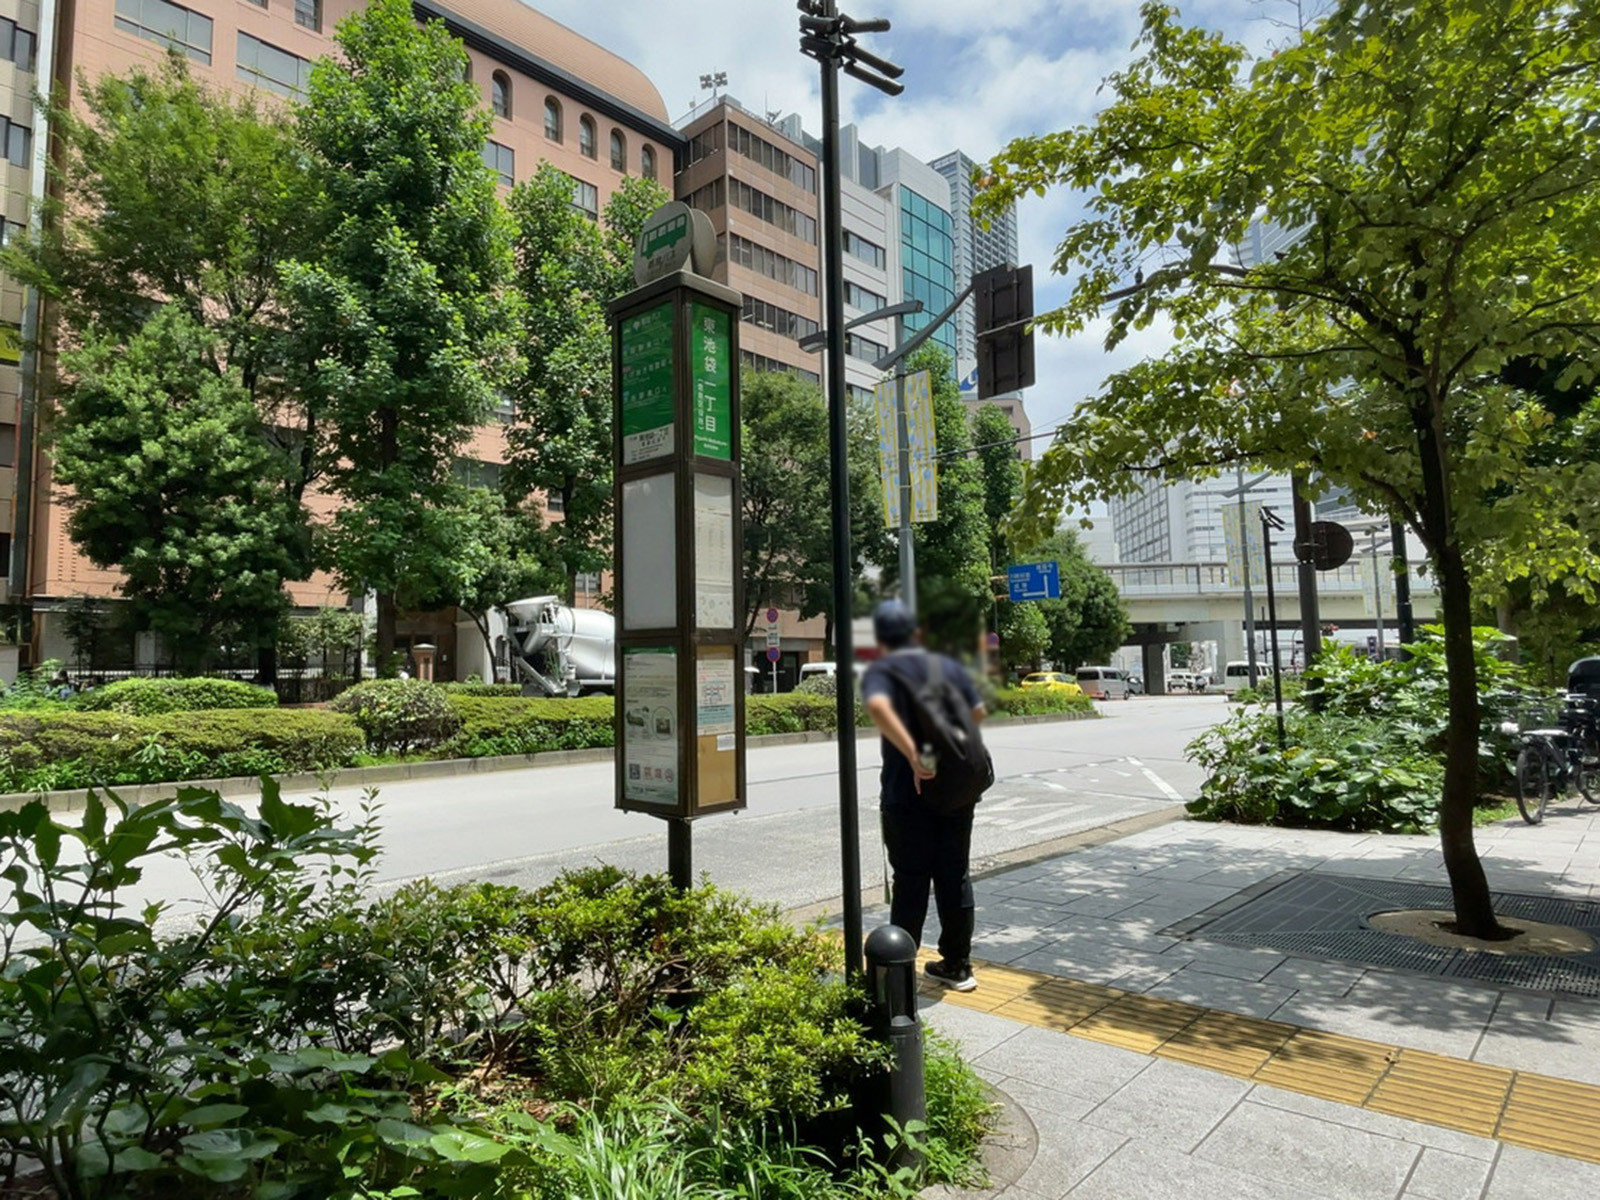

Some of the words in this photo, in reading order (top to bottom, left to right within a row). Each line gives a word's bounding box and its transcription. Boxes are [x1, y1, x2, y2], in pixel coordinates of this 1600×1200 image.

[704, 317, 716, 432] 東池袋一丁目
